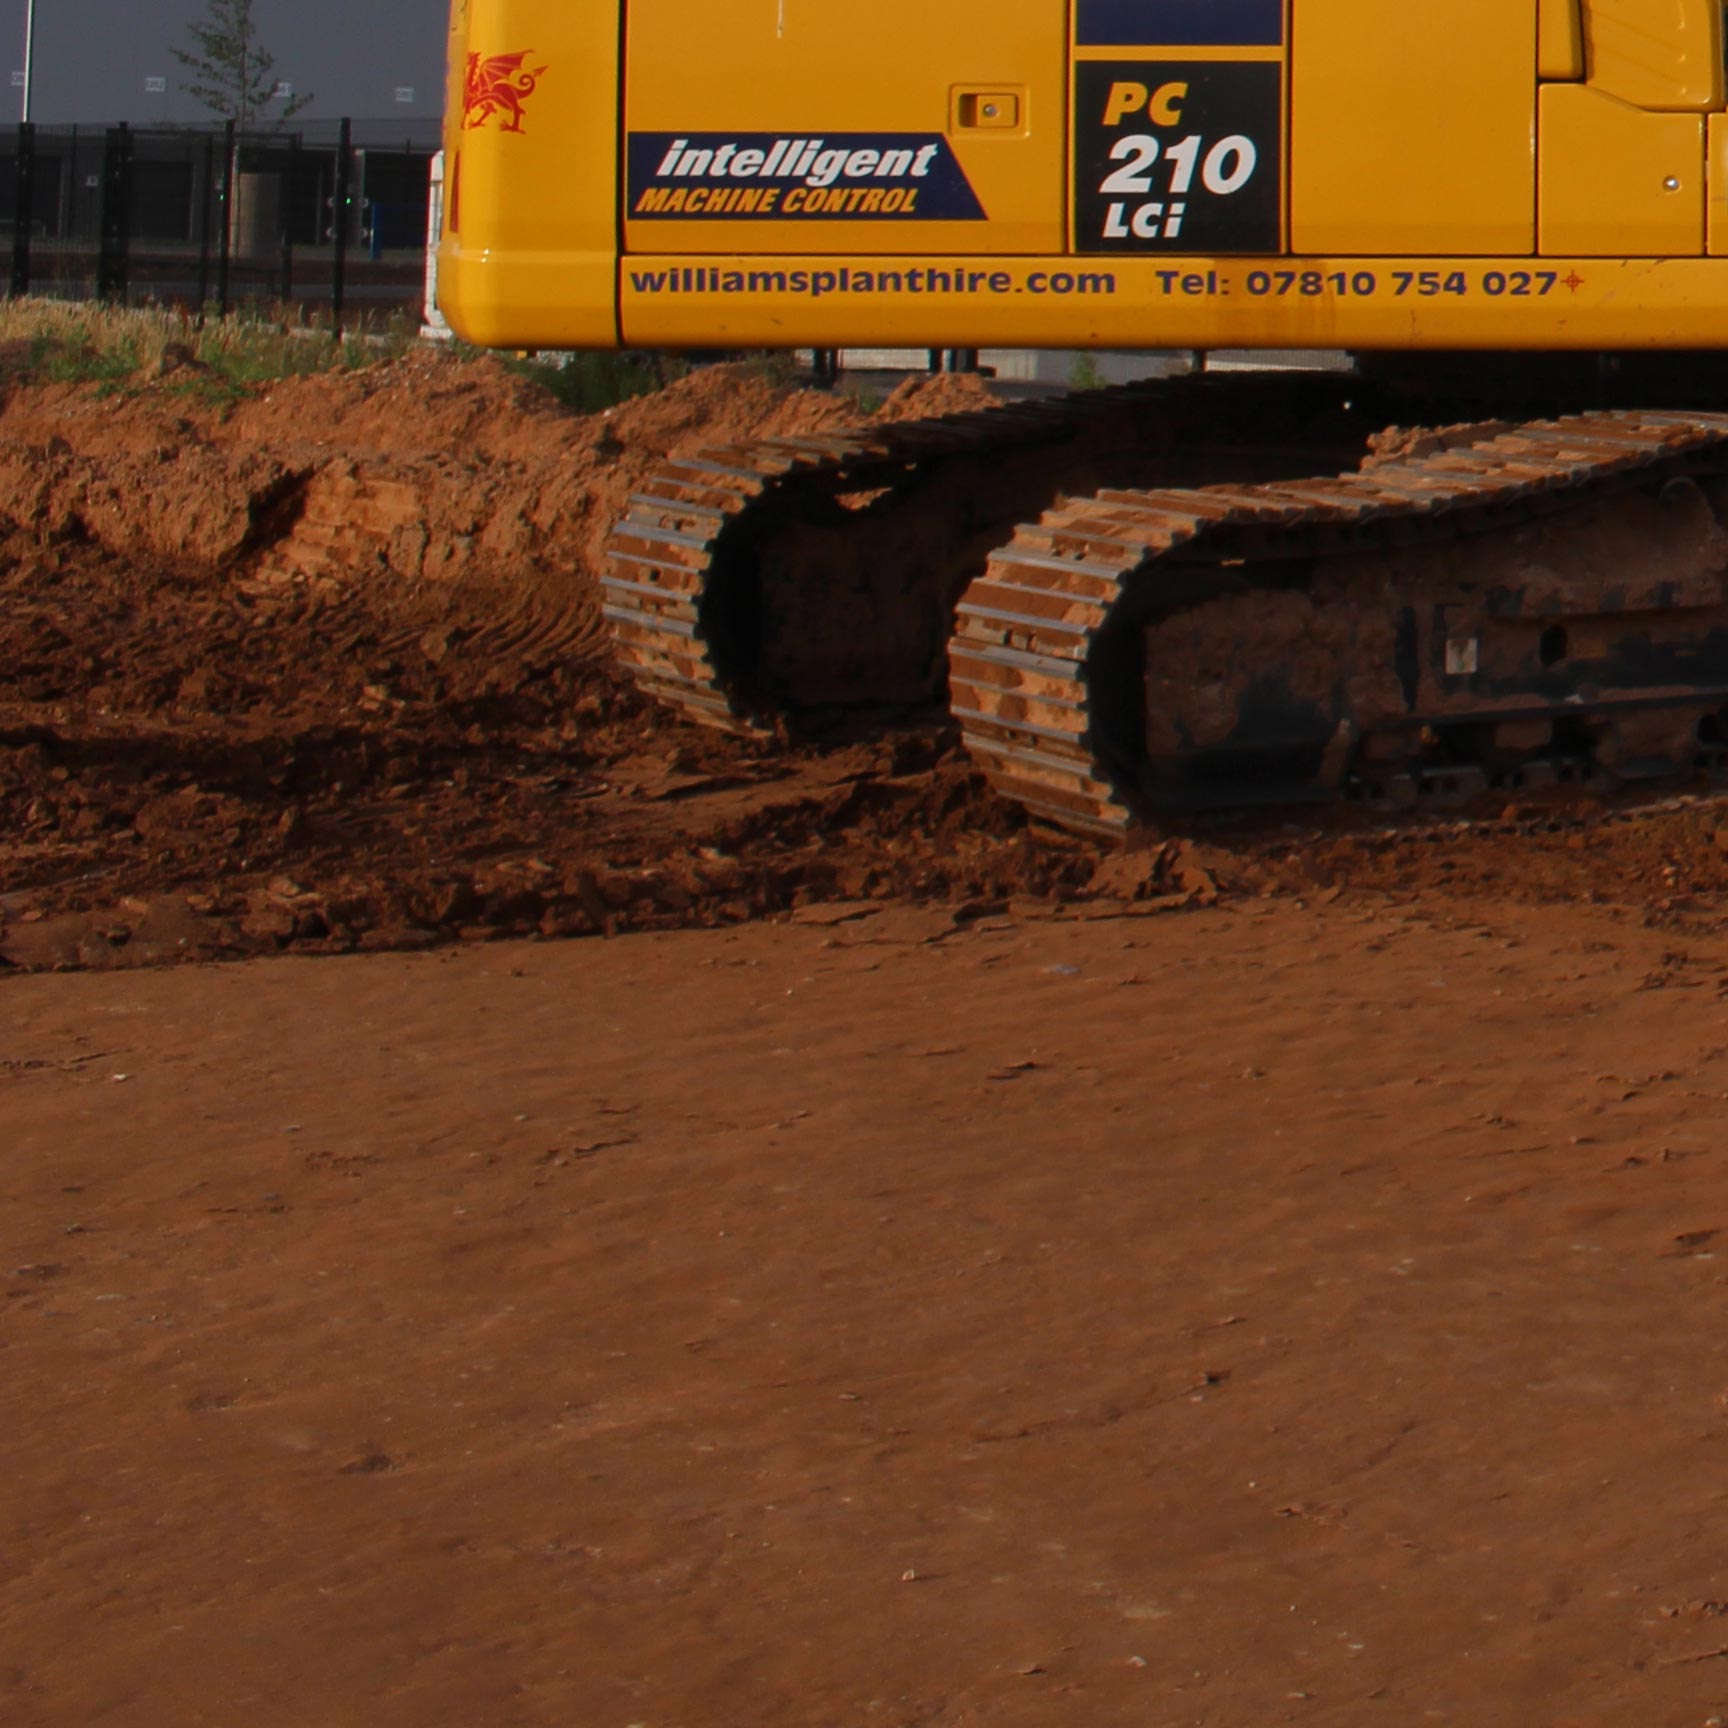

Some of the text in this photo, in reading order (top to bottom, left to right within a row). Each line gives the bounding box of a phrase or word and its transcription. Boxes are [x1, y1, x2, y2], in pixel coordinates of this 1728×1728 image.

[1103, 82, 1188, 126] PC
[656, 138, 938, 187] intelligent
[1100, 134, 1258, 195] 210
[634, 187, 917, 213] MACHINE CONTROL
[1102, 202, 1186, 239] LCi
[630, 267, 1558, 297] williamsplanthire.com Tel: 07810 754 027
